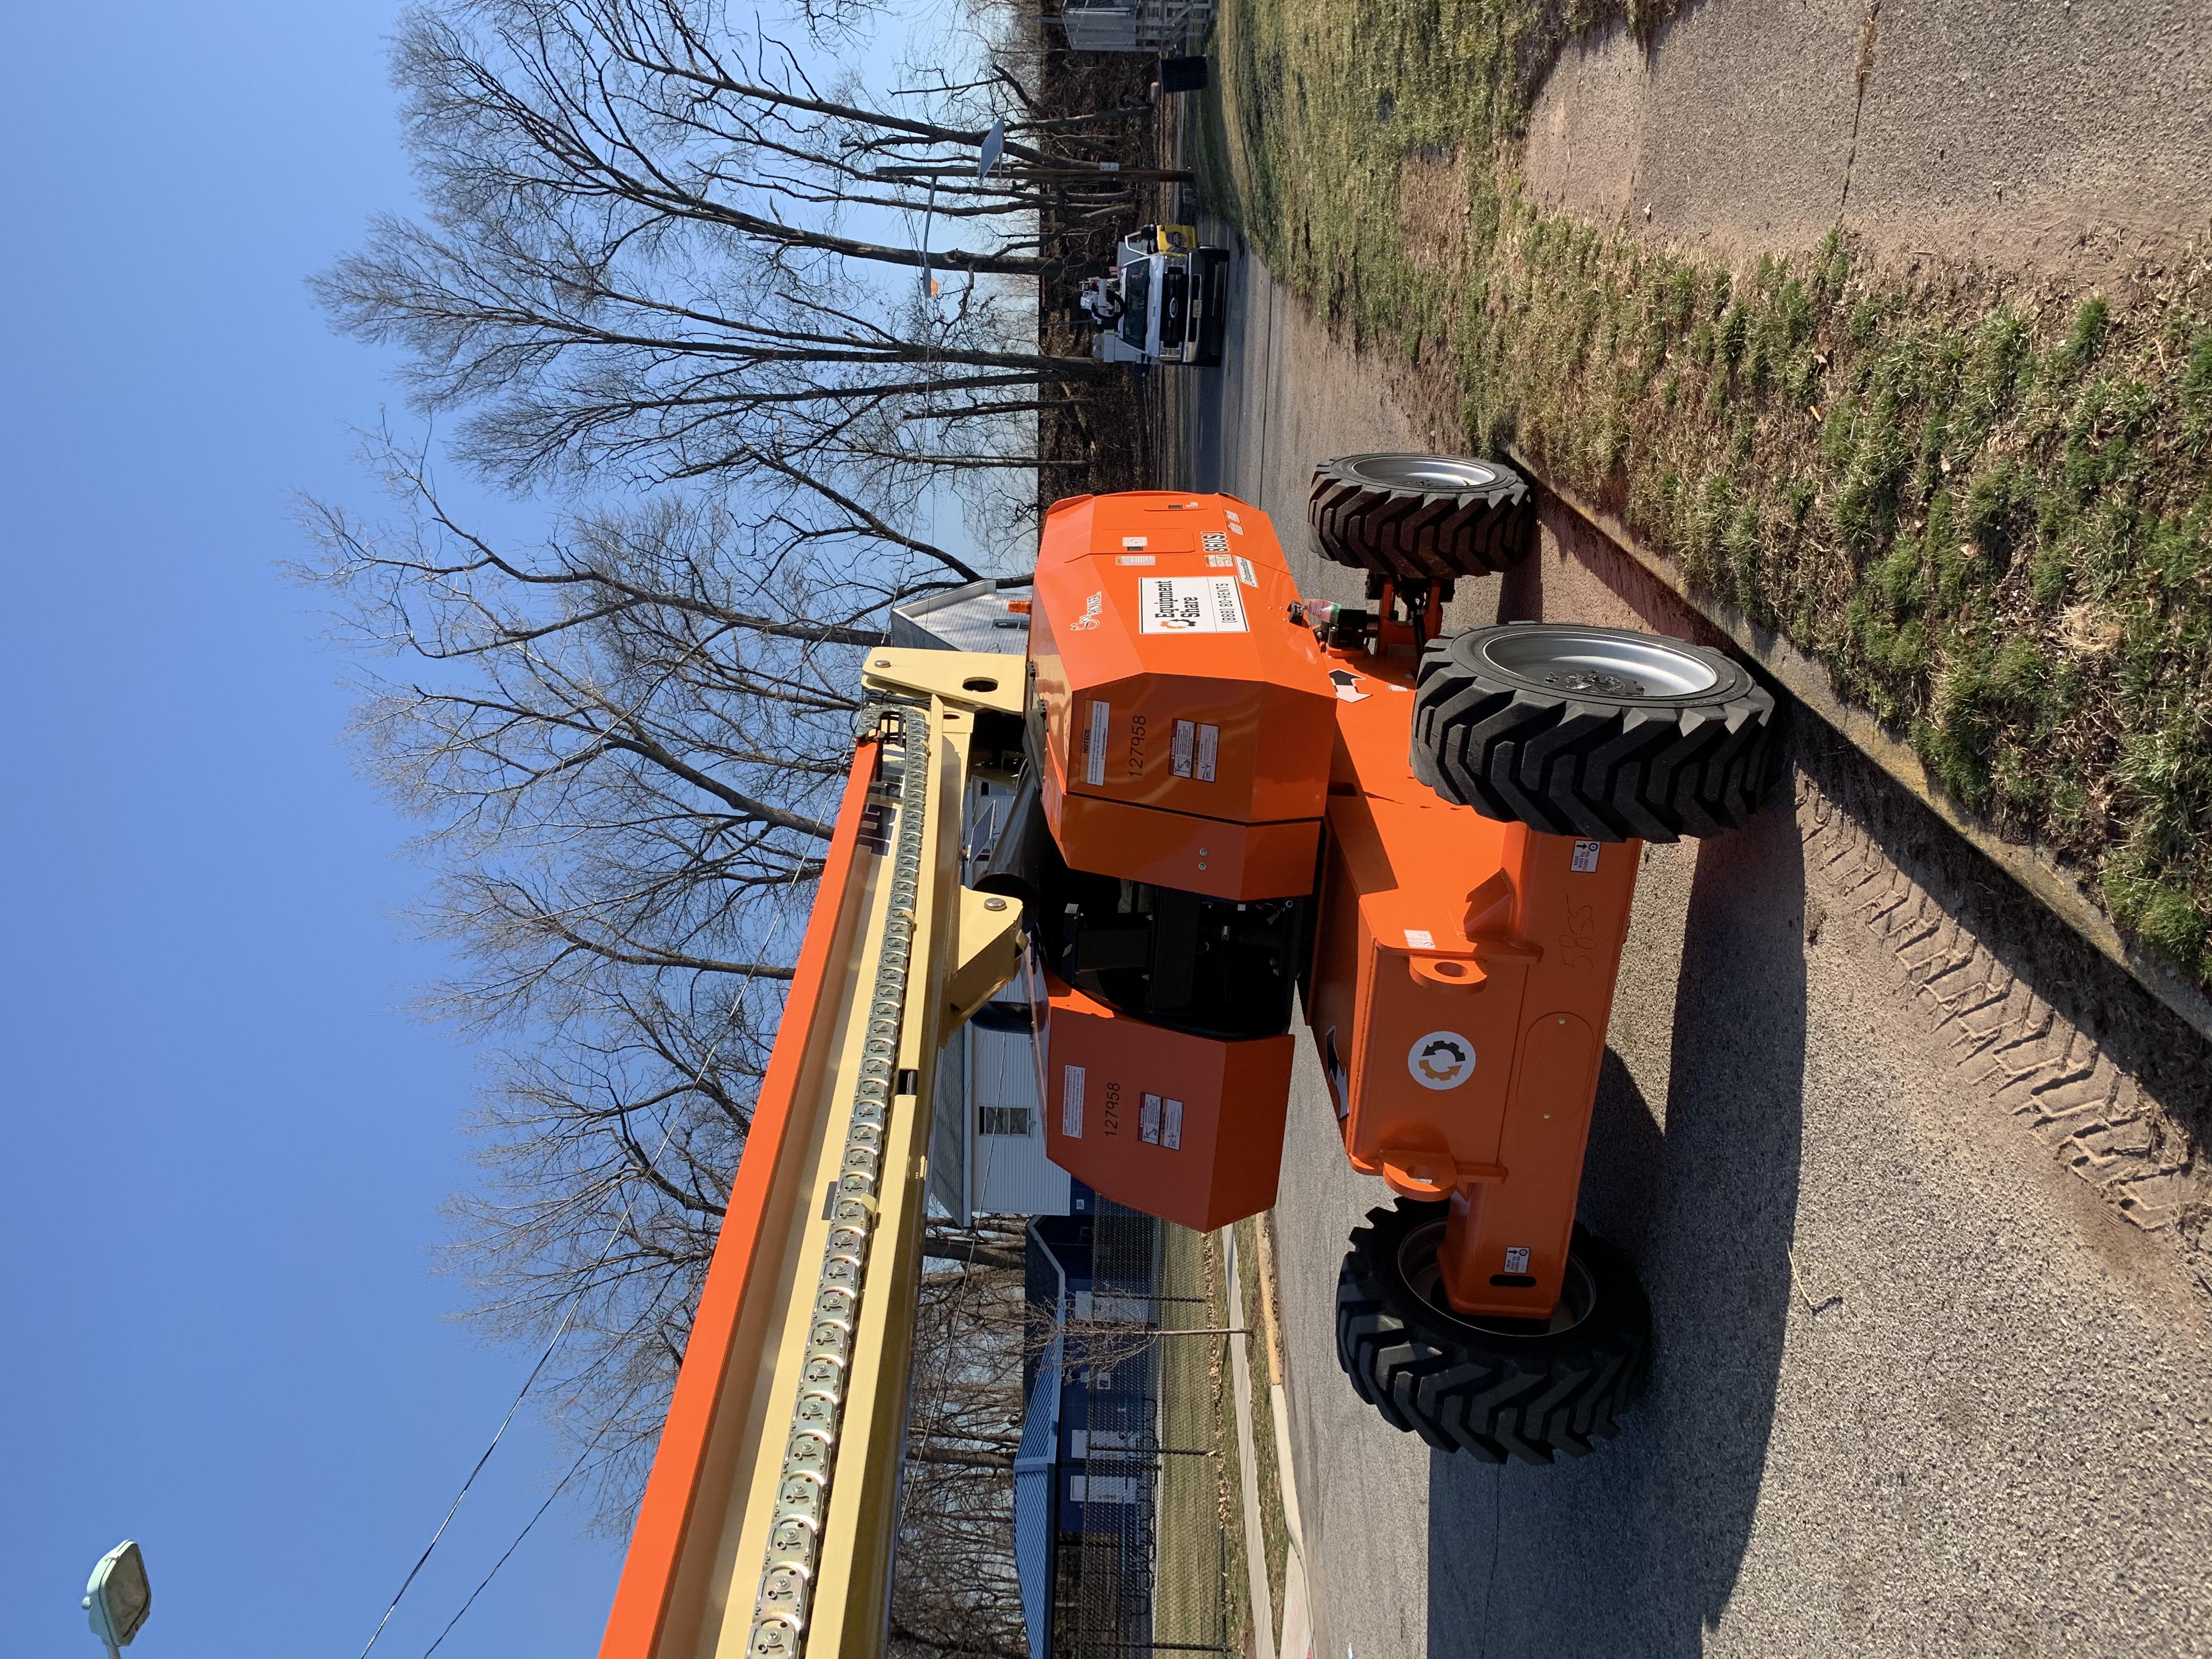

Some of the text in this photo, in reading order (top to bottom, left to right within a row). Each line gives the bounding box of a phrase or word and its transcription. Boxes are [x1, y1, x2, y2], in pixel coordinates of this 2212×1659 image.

[1200, 531, 1230, 552] 860SJ
[1154, 580, 1178, 618] Equipment
[1180, 597, 1200, 618] Share
[1216, 583, 1233, 607] 80-RENTS
[1219, 608, 1238, 623] (888)
[1128, 715, 1147, 777] 127958
[1559, 895, 1596, 973] 5855
[1104, 1082, 1120, 1137] 127958
